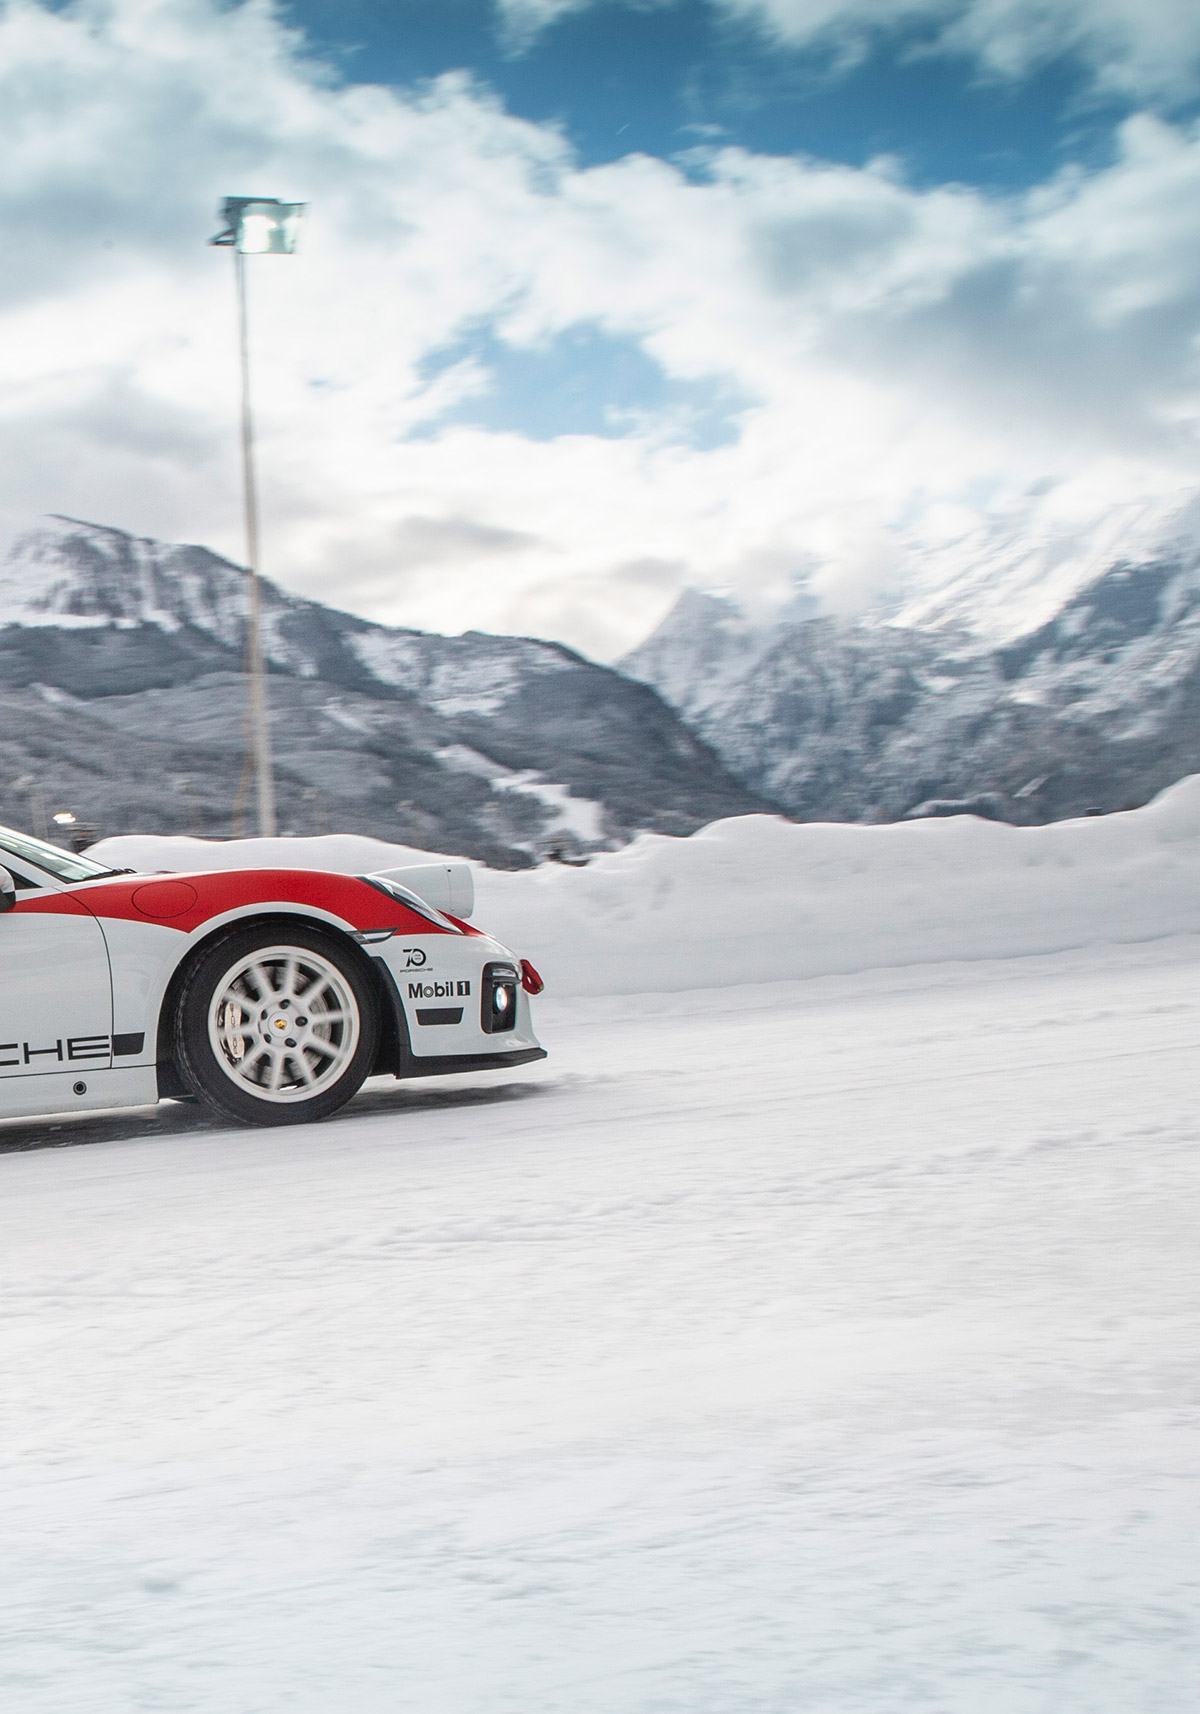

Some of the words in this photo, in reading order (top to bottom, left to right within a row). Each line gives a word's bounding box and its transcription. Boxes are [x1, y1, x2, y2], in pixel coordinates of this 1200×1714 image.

[402, 948, 426, 967] 70
[408, 981, 453, 999] Mobil
[457, 981, 470, 996] 1
